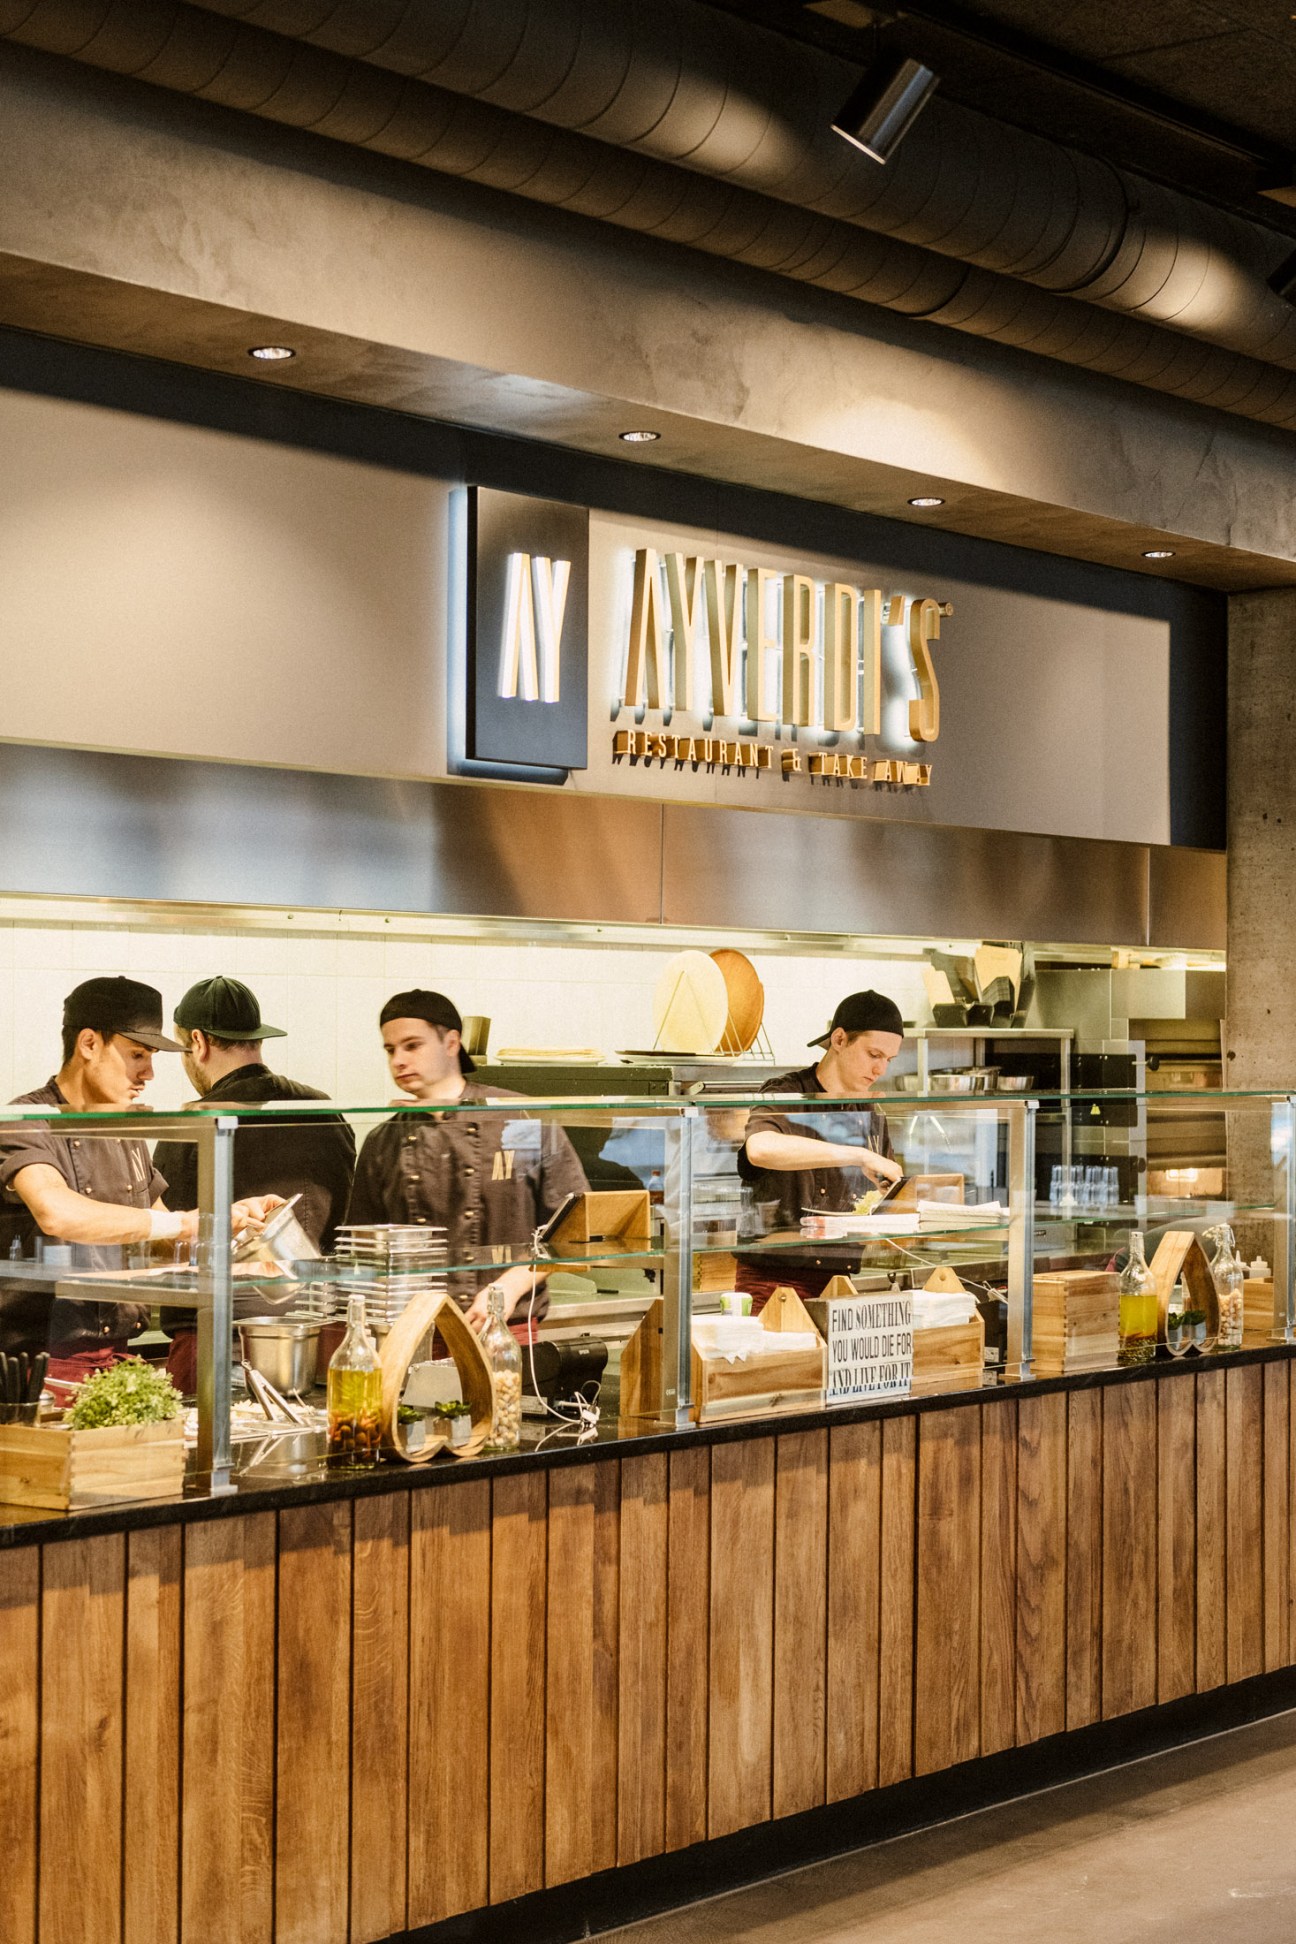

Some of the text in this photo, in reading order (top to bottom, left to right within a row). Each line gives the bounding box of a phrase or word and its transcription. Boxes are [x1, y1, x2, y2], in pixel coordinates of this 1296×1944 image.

[497, 552, 571, 703] AY
[622, 729, 933, 787] RESTAURANT & TAKE AWAY
[491, 1150, 515, 1181] AY
[832, 1301, 911, 1333] FIND SOMETHING
[832, 1332, 912, 1363] YOU WOULD DIE FOR
[830, 1361, 911, 1396] AND LIVE FOR IT
